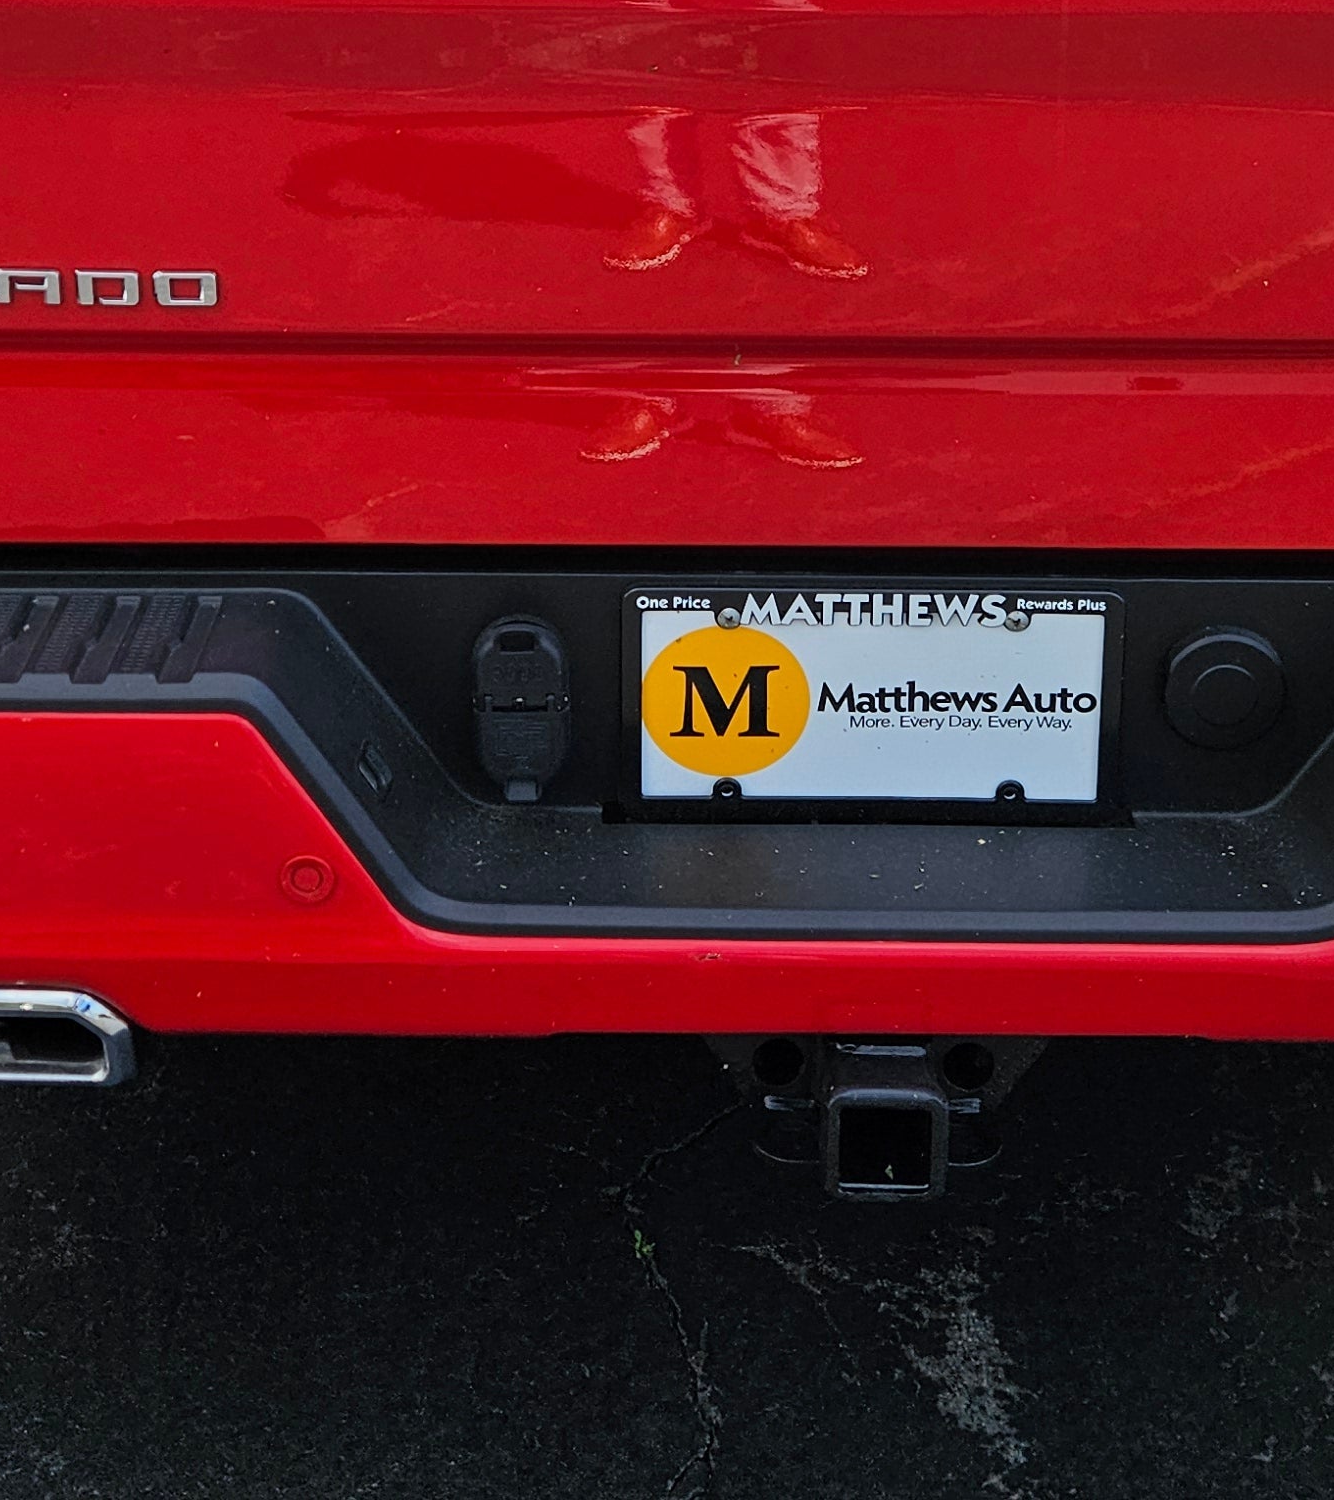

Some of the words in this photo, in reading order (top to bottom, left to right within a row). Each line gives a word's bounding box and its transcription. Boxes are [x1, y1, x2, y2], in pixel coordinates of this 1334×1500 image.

[636, 596, 668, 609] One
[673, 596, 711, 609] Price
[739, 592, 1008, 628] MATTHEWS
[1017, 598, 1074, 611] Rewards
[1077, 599, 1107, 612] Plus
[669, 665, 780, 738] M
[817, 680, 998, 714] Matthews
[1002, 683, 1098, 714] Auto
[849, 715, 896, 729] More.
[899, 715, 945, 731] Every
[948, 715, 983, 731] Day.
[987, 715, 1033, 732] Every
[1036, 716, 1073, 733] Way.
